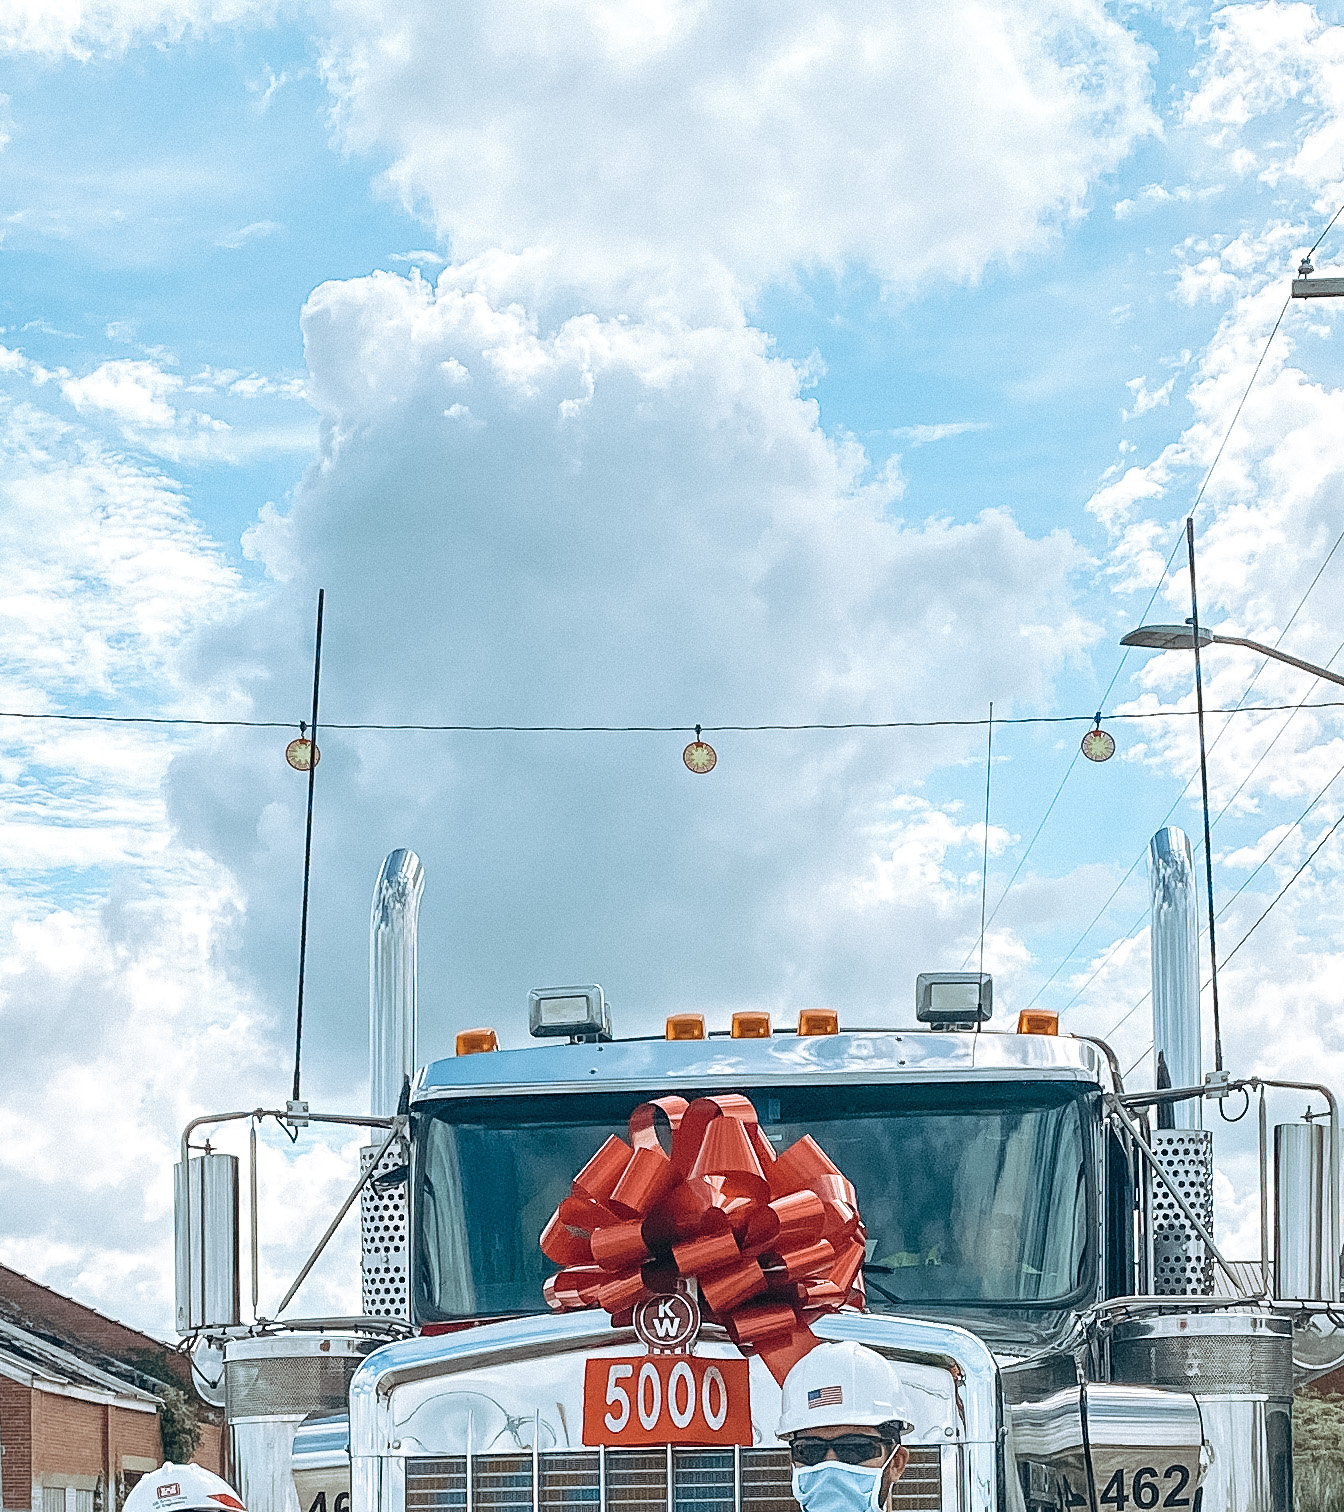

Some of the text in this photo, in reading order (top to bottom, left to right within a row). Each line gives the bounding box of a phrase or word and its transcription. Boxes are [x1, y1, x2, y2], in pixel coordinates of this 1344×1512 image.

[658, 1299, 676, 1318] K
[652, 1318, 681, 1337] W
[604, 1361, 729, 1433] 5000
[1100, 1464, 1190, 1511] 462
